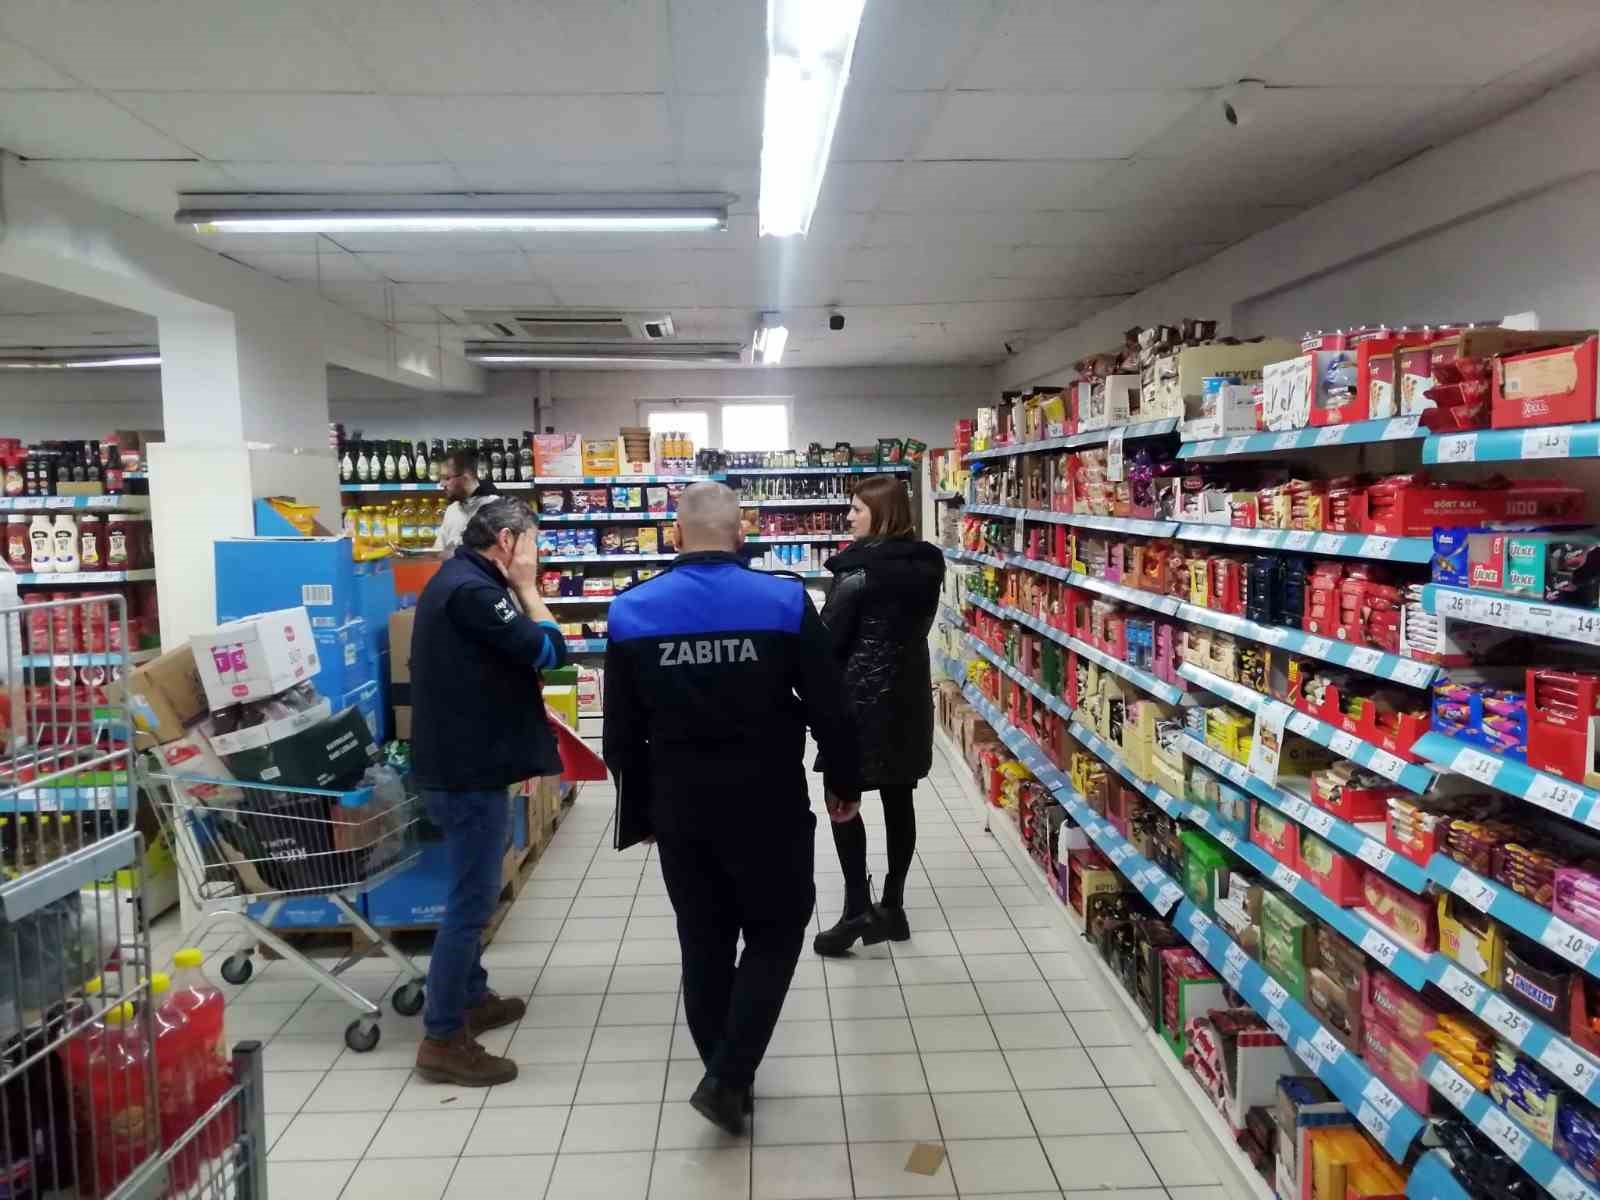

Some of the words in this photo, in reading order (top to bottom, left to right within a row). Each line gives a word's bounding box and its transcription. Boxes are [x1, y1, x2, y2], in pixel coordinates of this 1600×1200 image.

[659, 638, 759, 666] ZABITA
[1565, 935, 1583, 952] 10
[1505, 967, 1514, 985] 2
[1459, 983, 1474, 998] 25
[1503, 1011, 1521, 1029] 25
[1573, 1063, 1584, 1077] 9
[1447, 1079, 1463, 1093] 17
[1502, 1126, 1520, 1145] 12
